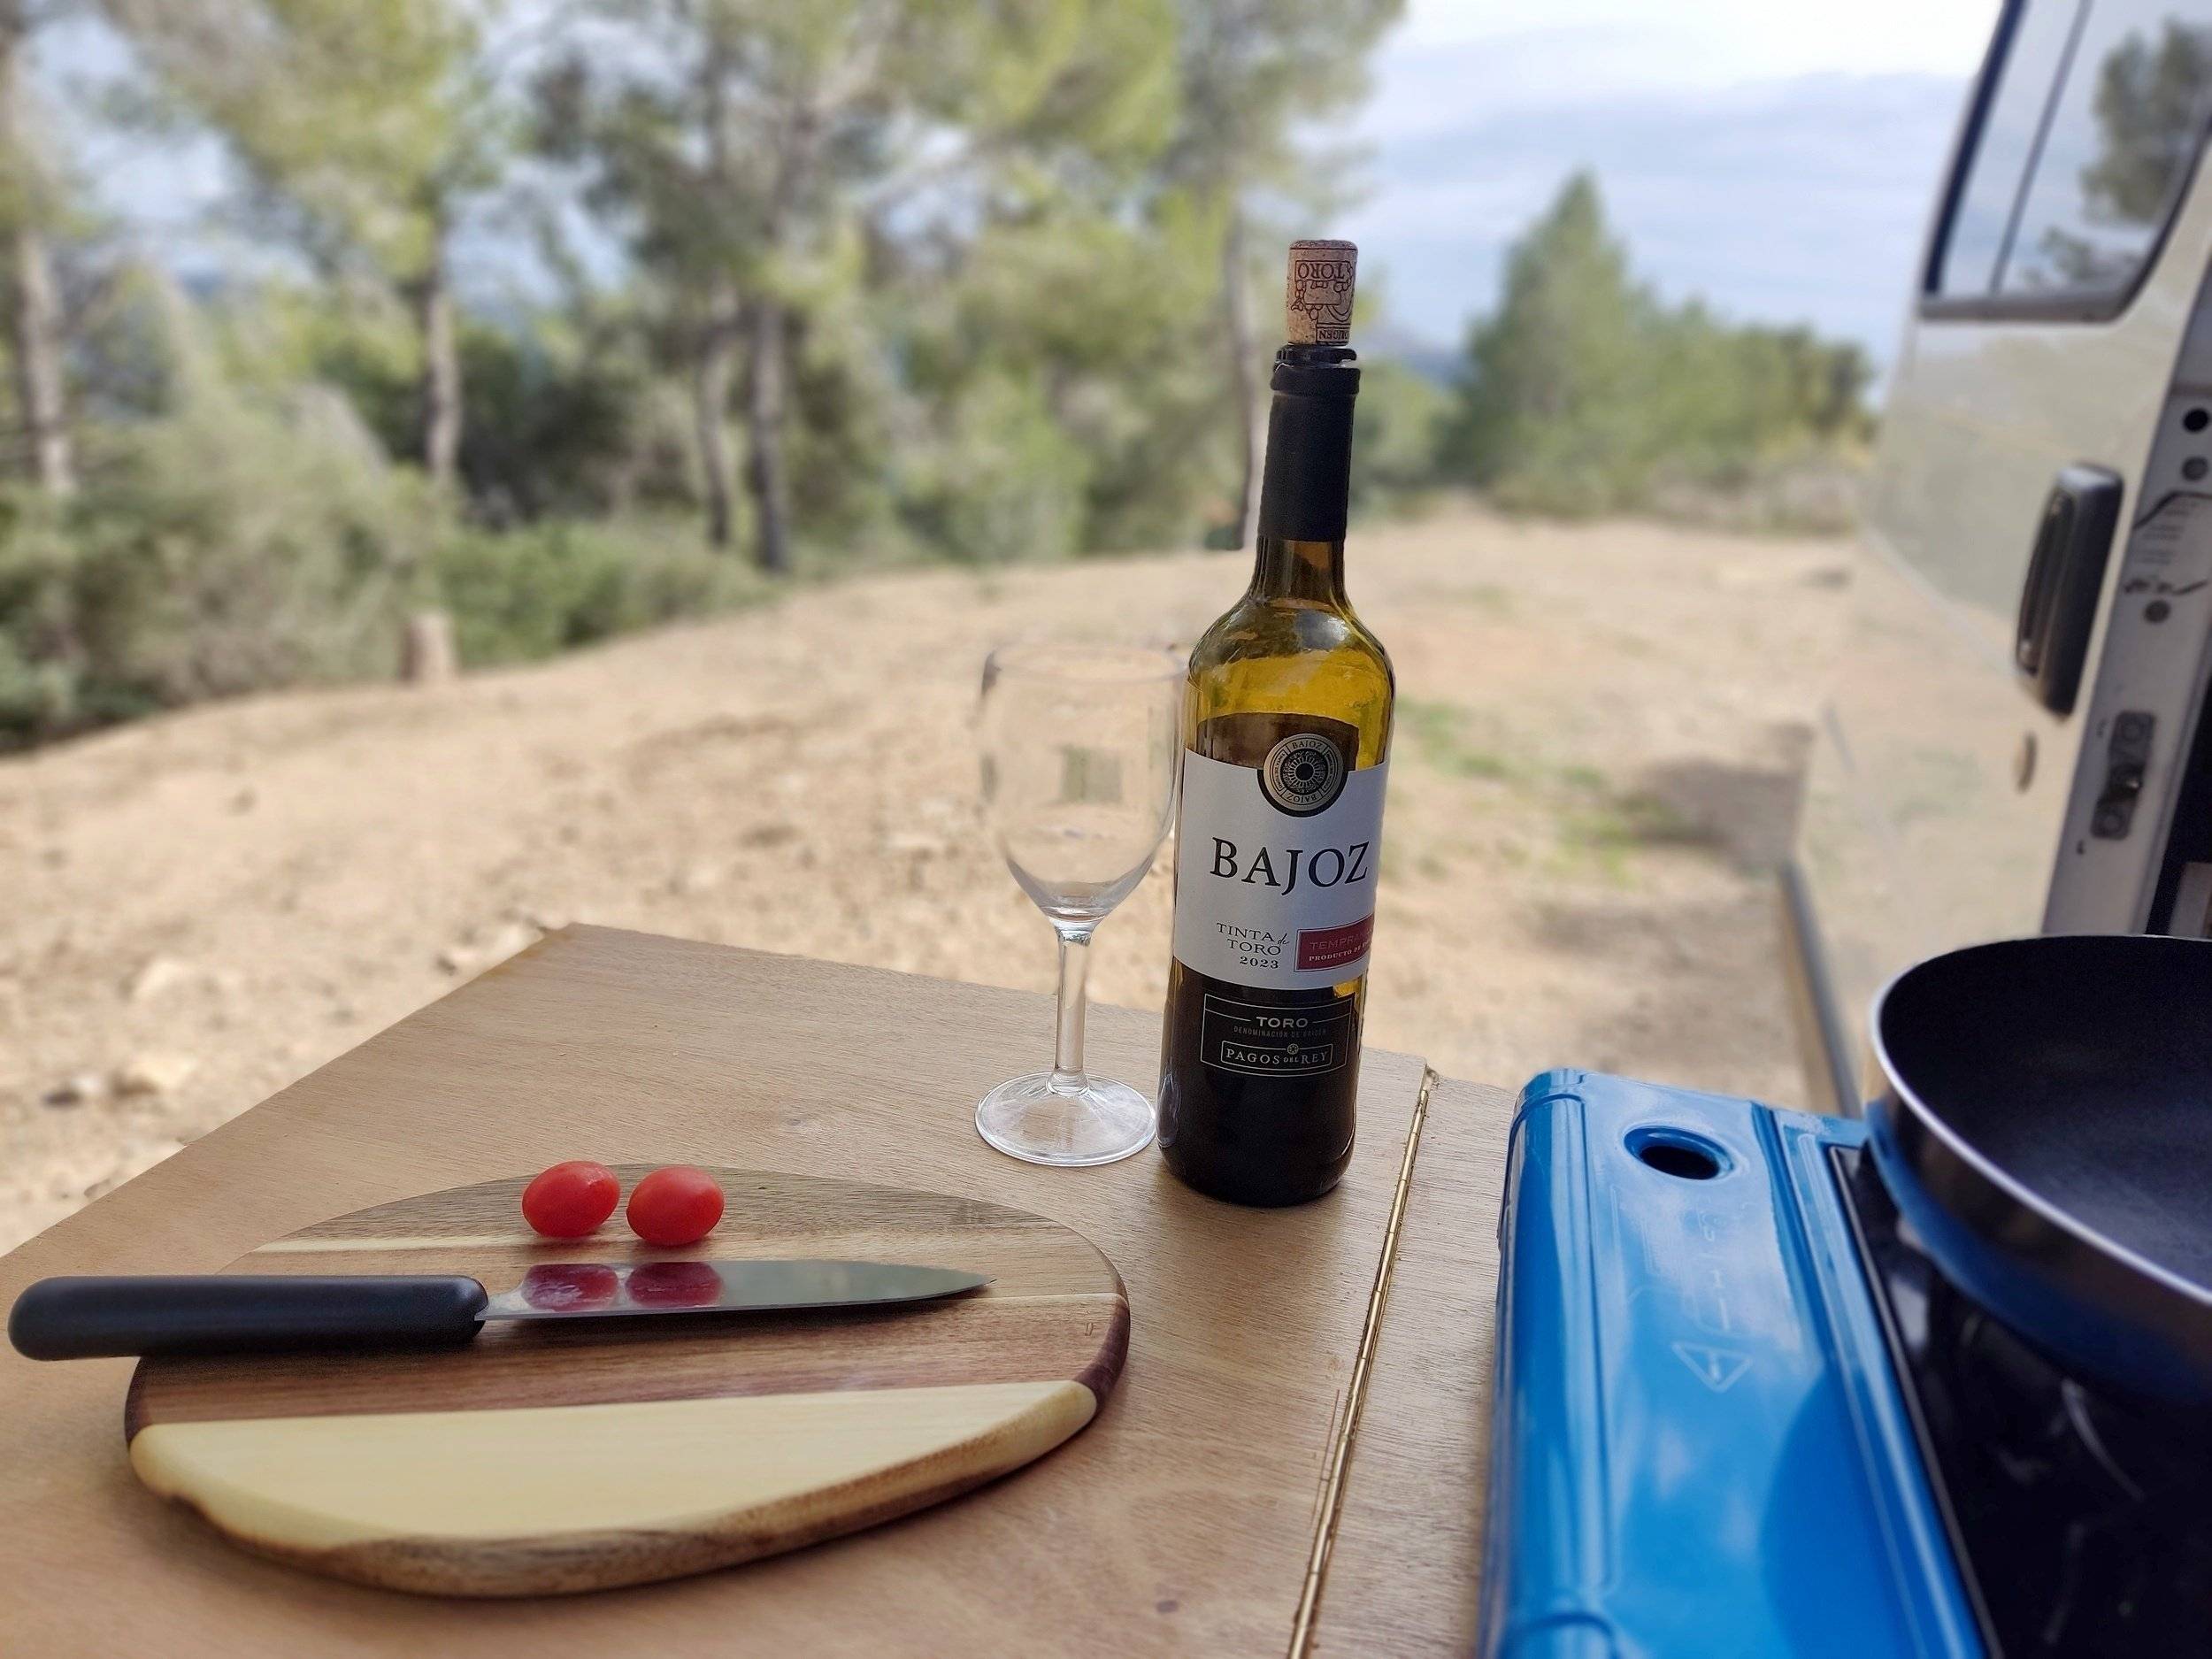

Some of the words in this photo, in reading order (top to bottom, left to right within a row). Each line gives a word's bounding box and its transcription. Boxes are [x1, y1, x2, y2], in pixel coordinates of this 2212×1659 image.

[1298, 263, 1345, 279] TORO
[1210, 837, 1370, 896] BAJOZ
[1216, 922, 1275, 942] TINTA
[1277, 933, 1290, 947] de
[1227, 938, 1281, 956] TORO
[1239, 956, 1279, 969] 2023
[1310, 949, 1352, 962] PRODUCTO
[1256, 1017, 1309, 1027] TORO
[1226, 1048, 1280, 1064] PAGOS
[1302, 1050, 1328, 1064] REY
